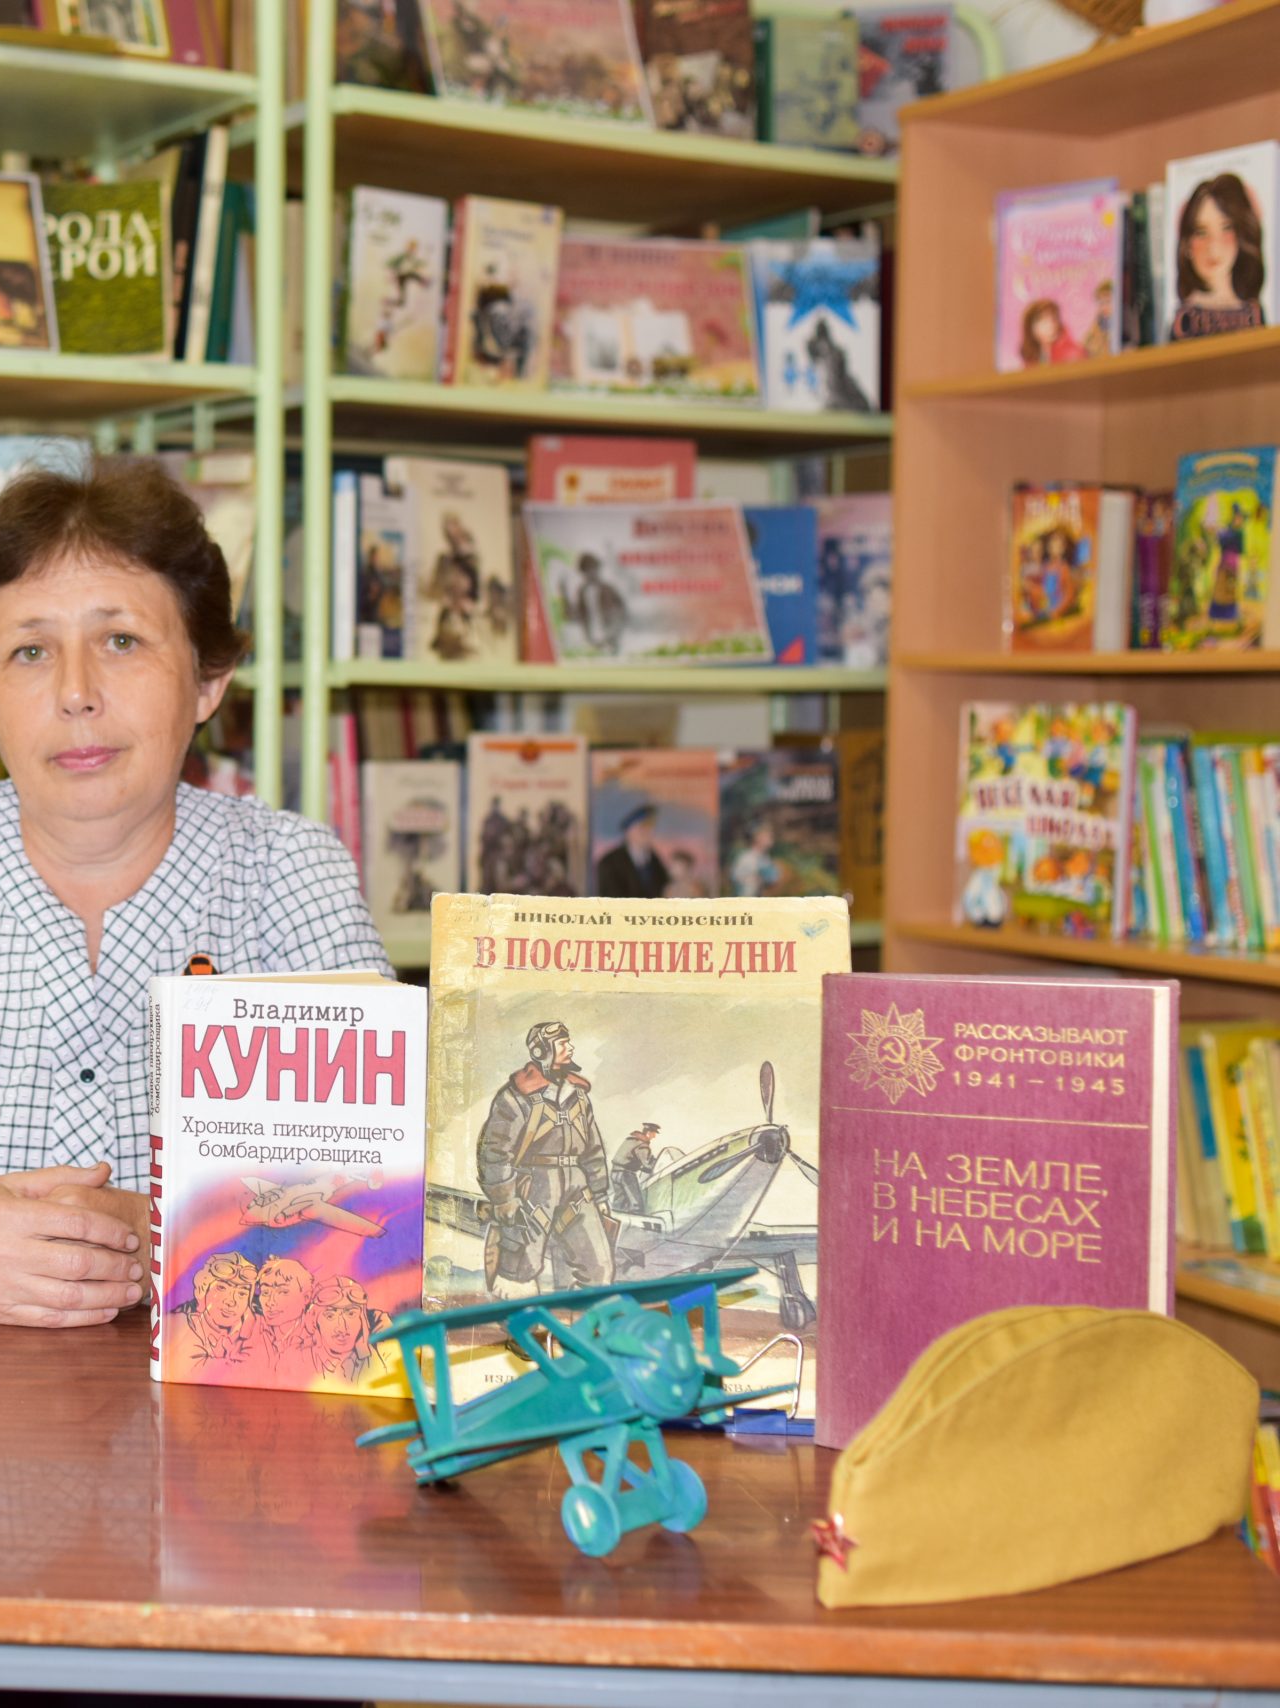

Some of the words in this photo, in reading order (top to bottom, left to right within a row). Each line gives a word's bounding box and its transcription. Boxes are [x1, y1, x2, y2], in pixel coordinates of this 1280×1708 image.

[513, 911, 613, 926] НИКОЛАЙ
[624, 911, 754, 926] ЧУКОВСКИЙ
[473, 935, 496, 969] В
[504, 936, 713, 978] ПОСЛЕДНИЕ
[718, 940, 798, 979] ДНИ
[233, 998, 365, 1026] Владимир
[954, 1022, 1128, 1046] РАССКАЗЫВАЮТ
[181, 1024, 406, 1106] КУНИН
[954, 1044, 1126, 1069] ФРОНТОВИКИ
[182, 1116, 264, 1138] Хроника
[273, 1122, 405, 1143] пикирующего
[199, 1140, 382, 1165] бомбардировщика
[873, 1148, 927, 1180] НА
[946, 1154, 1108, 1198] ЗЕМЛЕ,
[873, 1182, 896, 1209] В
[910, 1186, 1101, 1228] НЕБЕСАХ
[873, 1215, 898, 1244] И
[916, 1219, 971, 1251] НА
[984, 1223, 1102, 1264] МОРЕ
